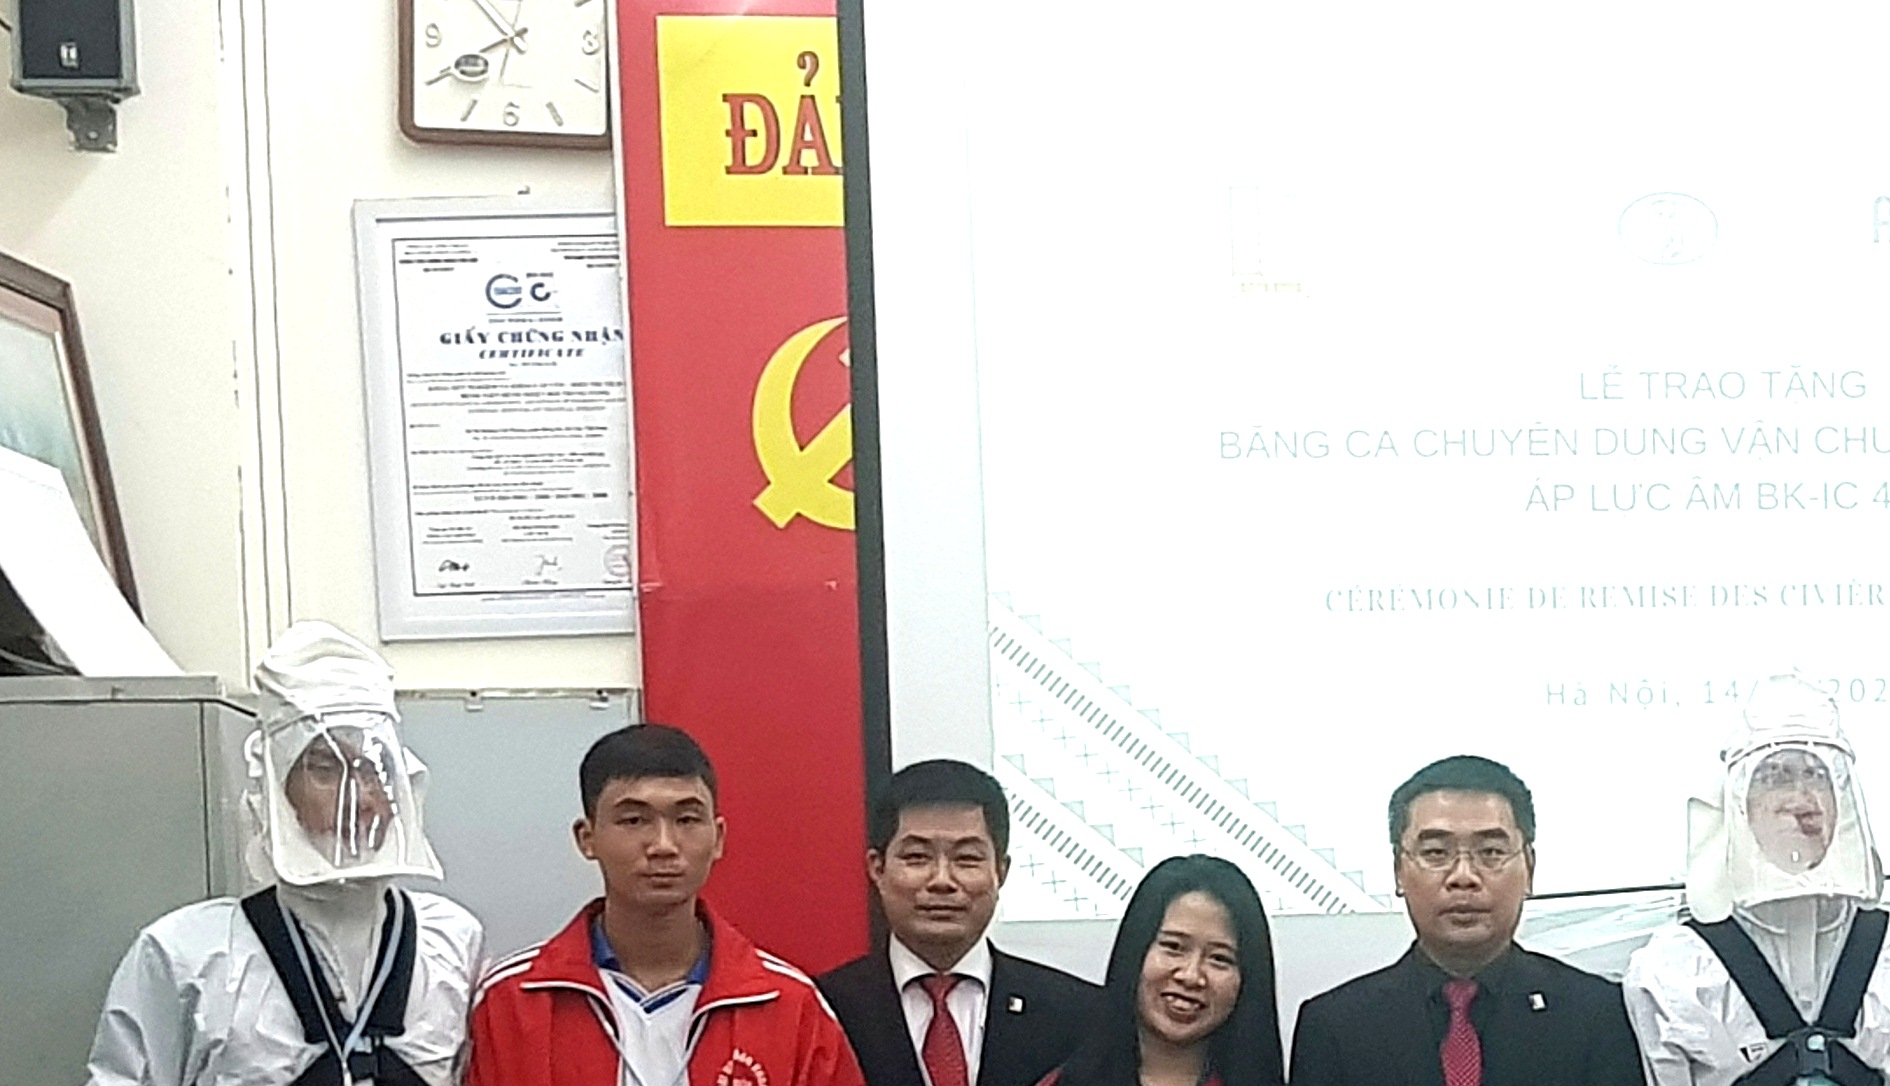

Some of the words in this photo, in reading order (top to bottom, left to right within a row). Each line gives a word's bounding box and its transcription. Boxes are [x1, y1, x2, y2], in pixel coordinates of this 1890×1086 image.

[503, 101, 520, 127] 6
[722, 50, 844, 175] ĐẢ
[1639, 371, 1746, 400] TRAO
[1345, 430, 1399, 459] CA
[1525, 477, 1575, 512] ÁP
[1685, 475, 1741, 511] ÂM
[1757, 481, 1858, 511] BK-IC
[1528, 586, 1566, 609] DE
[1580, 585, 1698, 609] REMISE
[1711, 584, 1768, 607] DES
[1546, 678, 1587, 706] Hà
